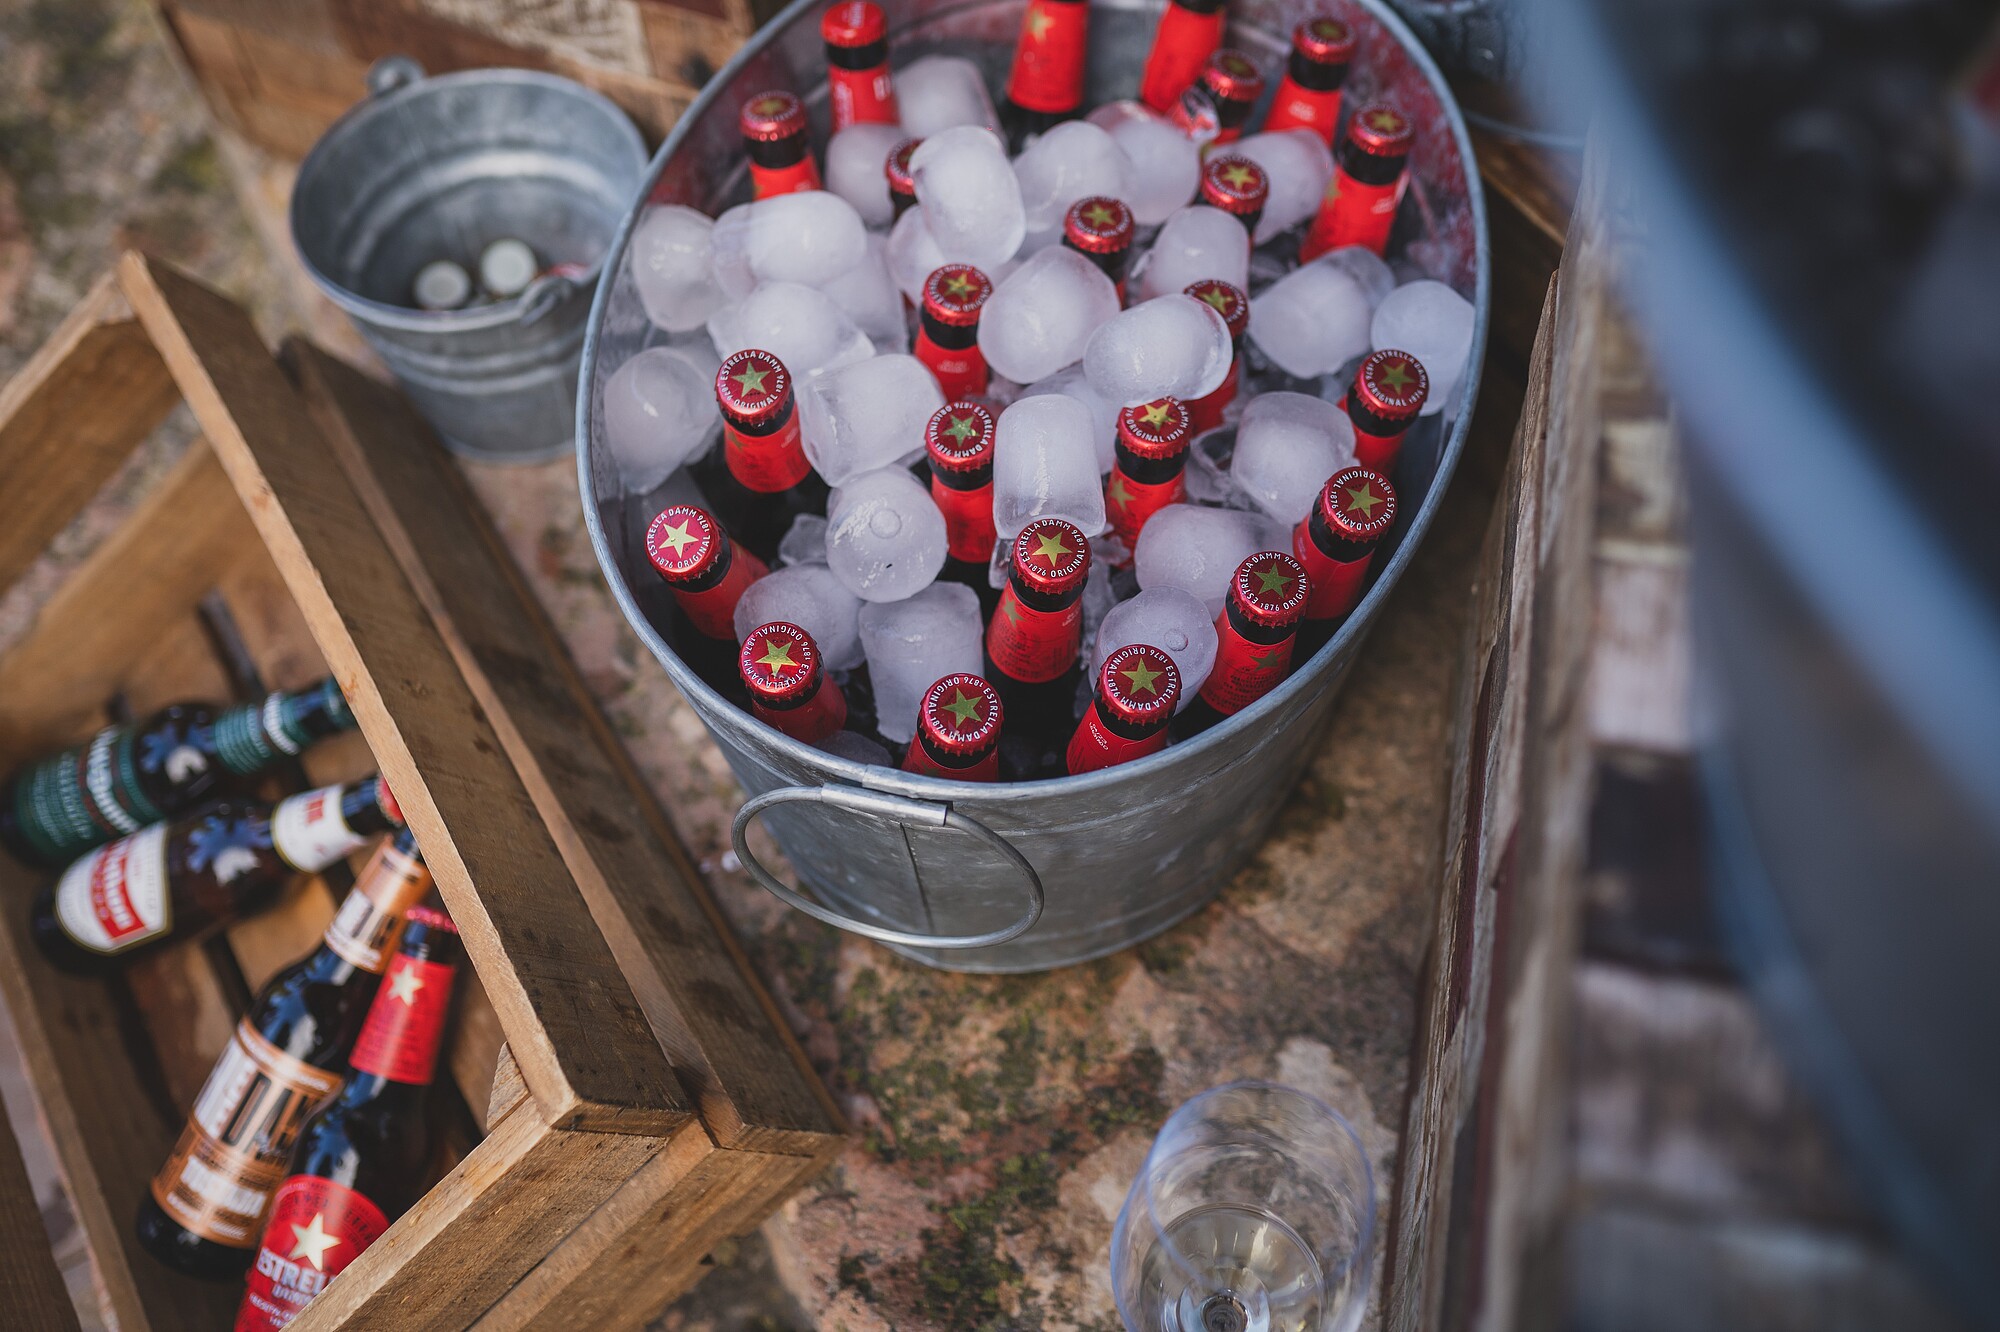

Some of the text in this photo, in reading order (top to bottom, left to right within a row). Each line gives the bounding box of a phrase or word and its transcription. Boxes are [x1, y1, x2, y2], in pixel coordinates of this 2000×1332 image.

[721, 351, 782, 380] ESTRELLA DAMM
[734, 394, 778, 409] ORIGINAL
[1368, 382, 1407, 406] ORIGINAL
[930, 405, 952, 442] ORIGINAL
[954, 407, 993, 458] ESTRELLA DAMM
[1126, 419, 1164, 442] ORIGINAL
[1167, 429, 1184, 440] 1876
[1178, 406, 1189, 428] DAMM
[1330, 471, 1392, 508] 1876 ORIGINAL 1876
[647, 507, 697, 556] ESTRELLA DAMM
[1336, 497, 1394, 530] ESTRELLA DAMM
[656, 515, 711, 568] 1876 ORIGINAL 1876
[1019, 520, 1070, 562] ESTRELLA DAMM
[1029, 530, 1085, 577] 1876 ORIGINAL 1876
[1240, 552, 1281, 604] ESTRELLA DAMM
[1260, 557, 1306, 611] 1876 ORIGINAL 1876
[744, 625, 811, 660] 1876 ORIGINAL 1876
[744, 659, 764, 686] DAMM
[1108, 648, 1168, 697] 1876 ORIGINAL 1876
[1153, 665, 1176, 707] ESTRELLA
[929, 677, 984, 734] 1876 ORIGINAL 1876
[949, 688, 998, 742] ESTRELLA DAMM
[1121, 696, 1151, 710] DAMM
[256, 1247, 335, 1295] ESTREL
